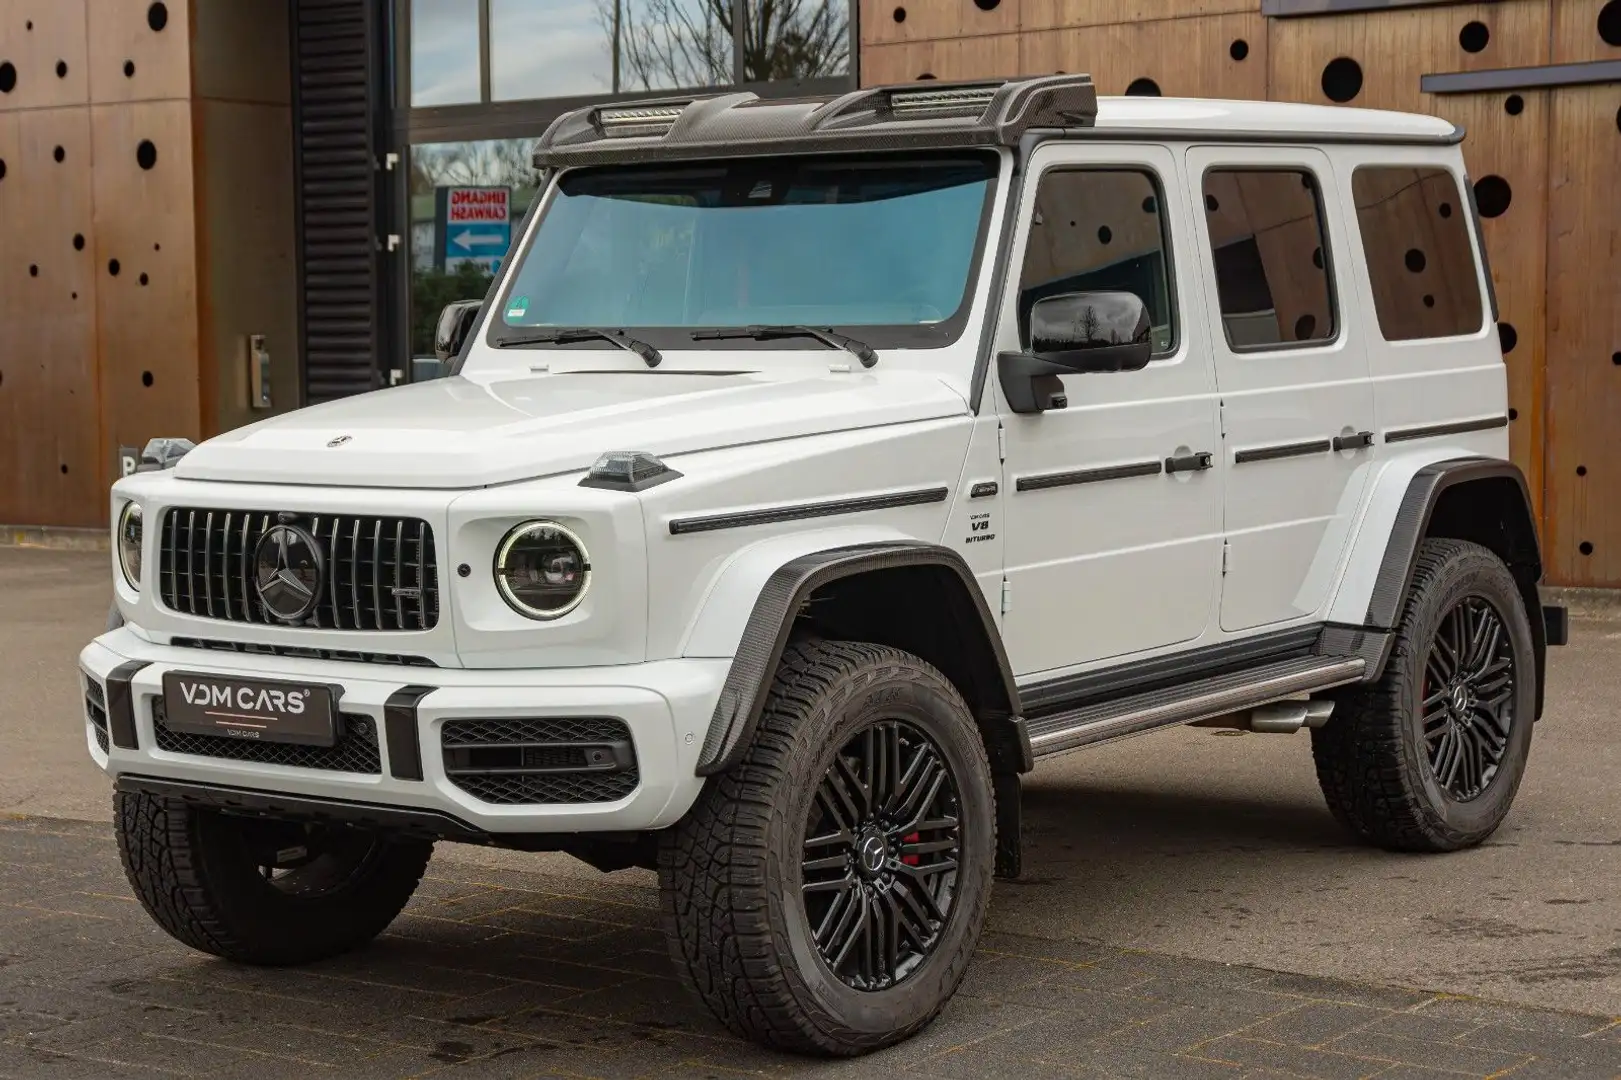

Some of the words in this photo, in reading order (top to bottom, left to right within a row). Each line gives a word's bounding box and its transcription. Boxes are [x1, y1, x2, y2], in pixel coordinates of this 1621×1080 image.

[122, 456, 136, 478] P
[972, 521, 989, 531] V8
[180, 681, 232, 708] VDM
[227, 728, 241, 737] VDM
[242, 730, 260, 739] CARS
